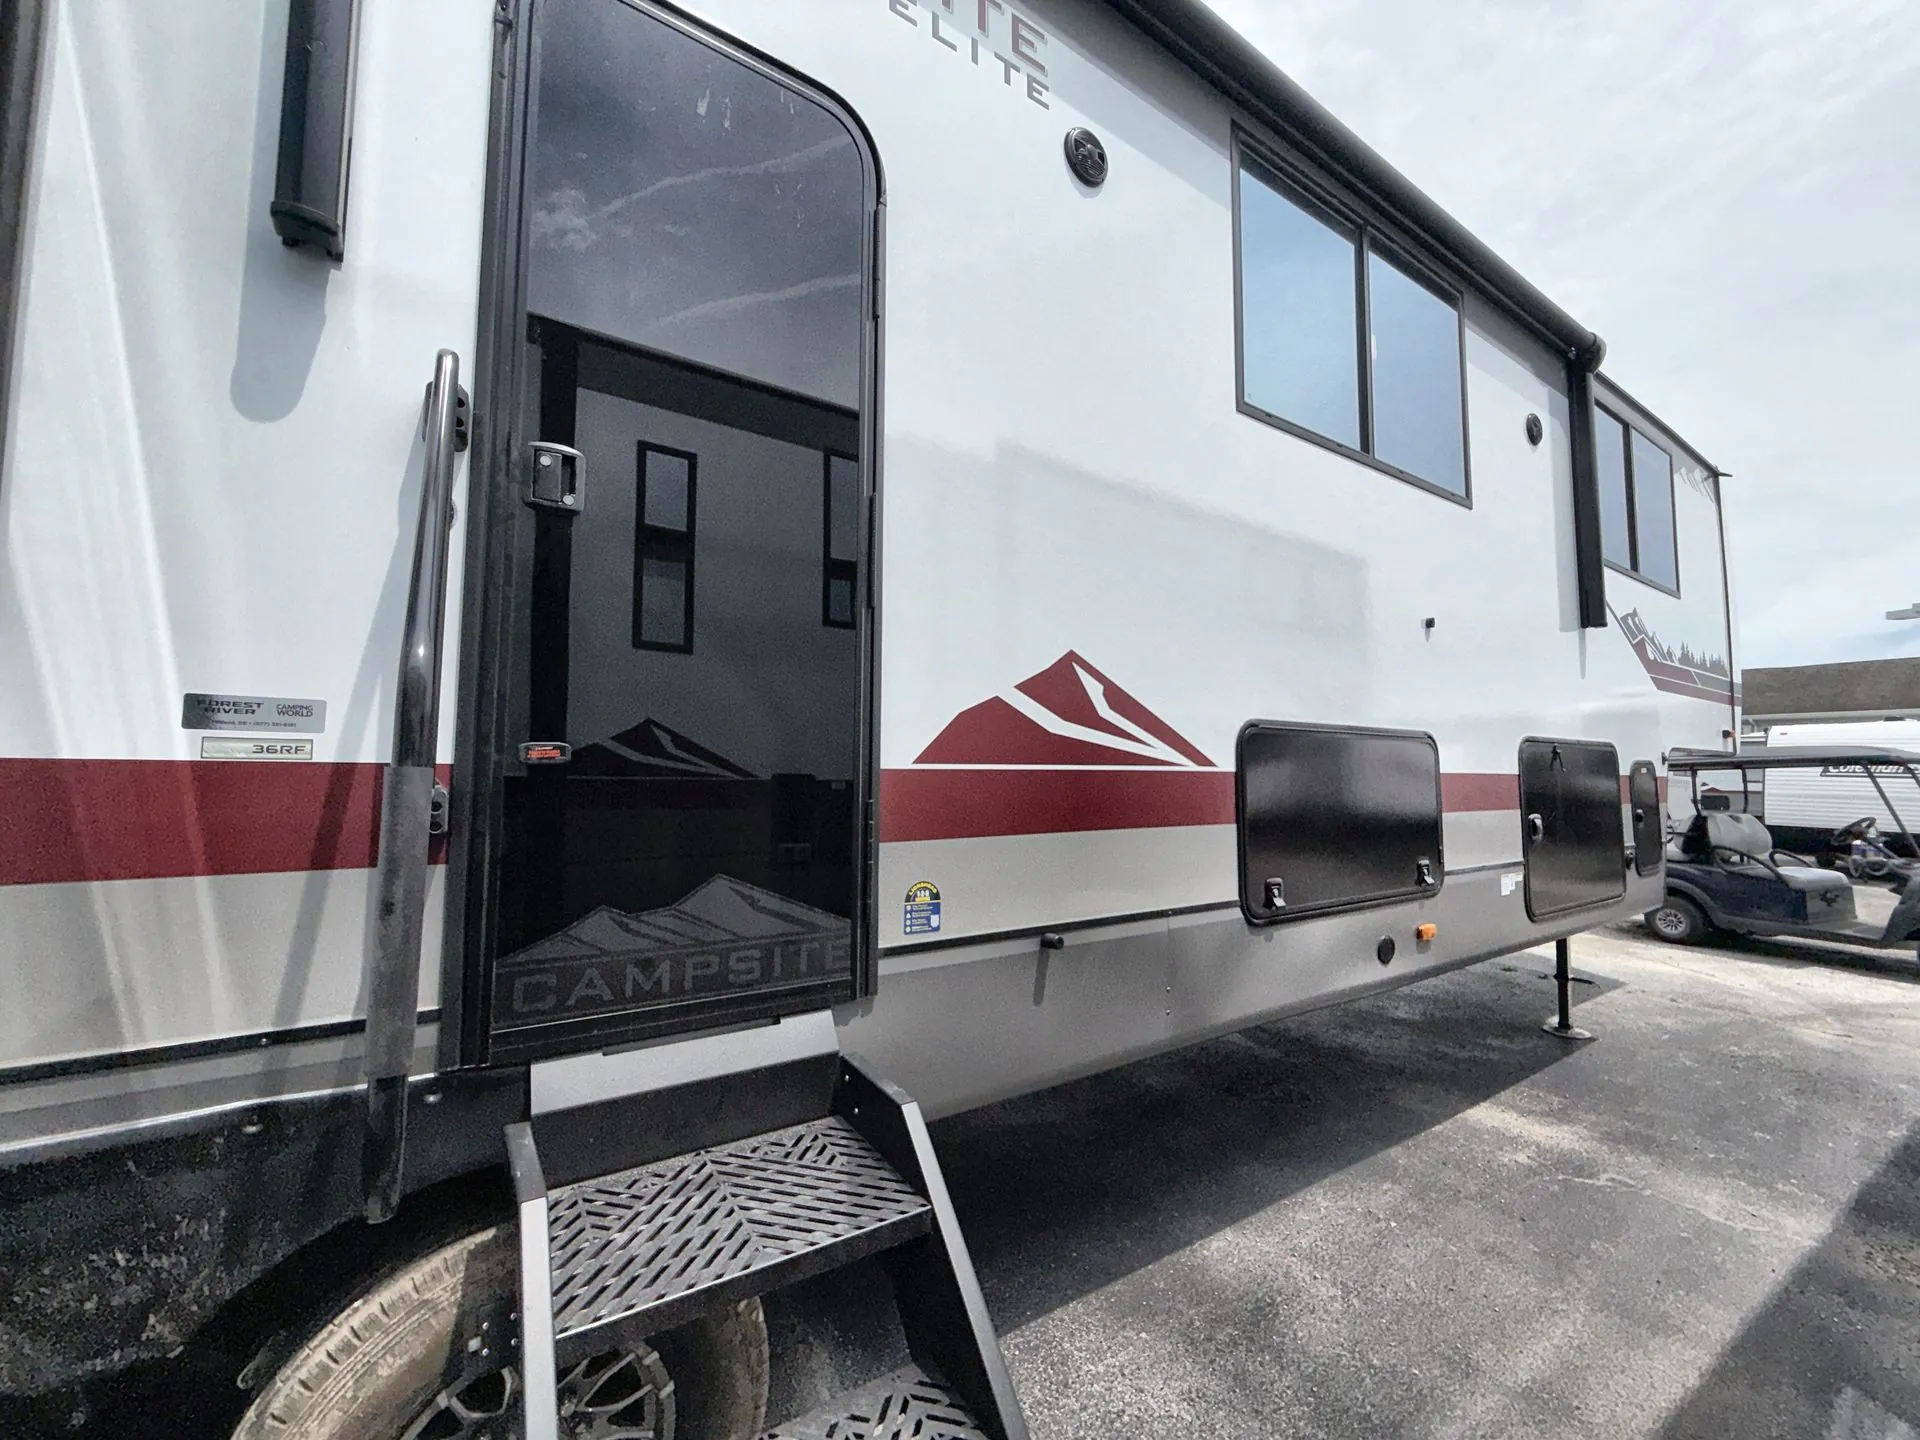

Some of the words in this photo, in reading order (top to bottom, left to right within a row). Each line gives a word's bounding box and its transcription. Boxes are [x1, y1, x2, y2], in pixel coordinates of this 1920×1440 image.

[889, 0, 1050, 110] ELITE
[197, 700, 264, 709] FOREST
[276, 703, 314, 711] CAMPING
[204, 707, 256, 715] RIVER
[276, 710, 314, 718] WORLD
[252, 744, 306, 755] 36RF
[512, 940, 851, 1013] CAMPSITE
